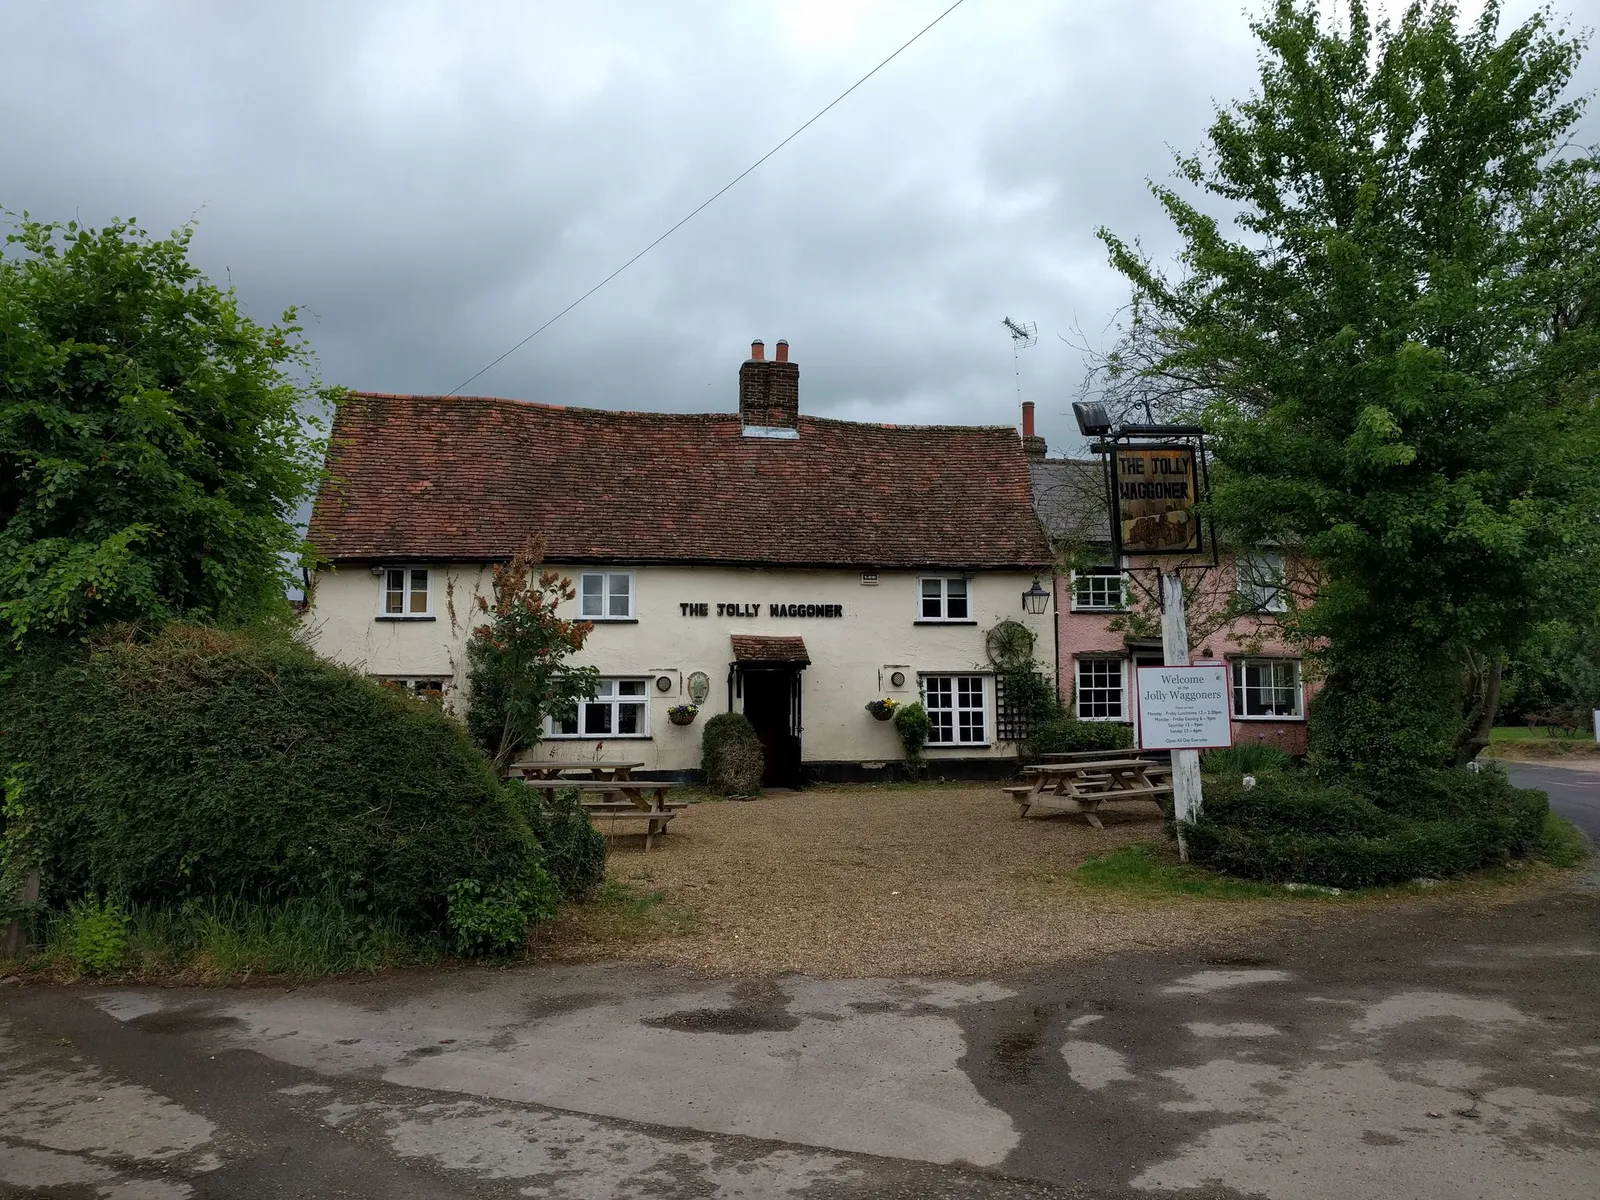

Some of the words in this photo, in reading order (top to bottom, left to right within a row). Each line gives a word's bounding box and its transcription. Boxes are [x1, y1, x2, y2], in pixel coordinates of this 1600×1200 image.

[1118, 457, 1144, 475] THE
[1151, 457, 1190, 475] JOLLY
[1118, 481, 1189, 500] WAGGONER
[679, 602, 708, 617] THE
[716, 603, 761, 617] JOLLY
[769, 603, 843, 618] WAGGONER
[1161, 674, 1204, 684] Welcome
[1144, 689, 1167, 702] Jolly
[1169, 690, 1222, 702] Waggoners
